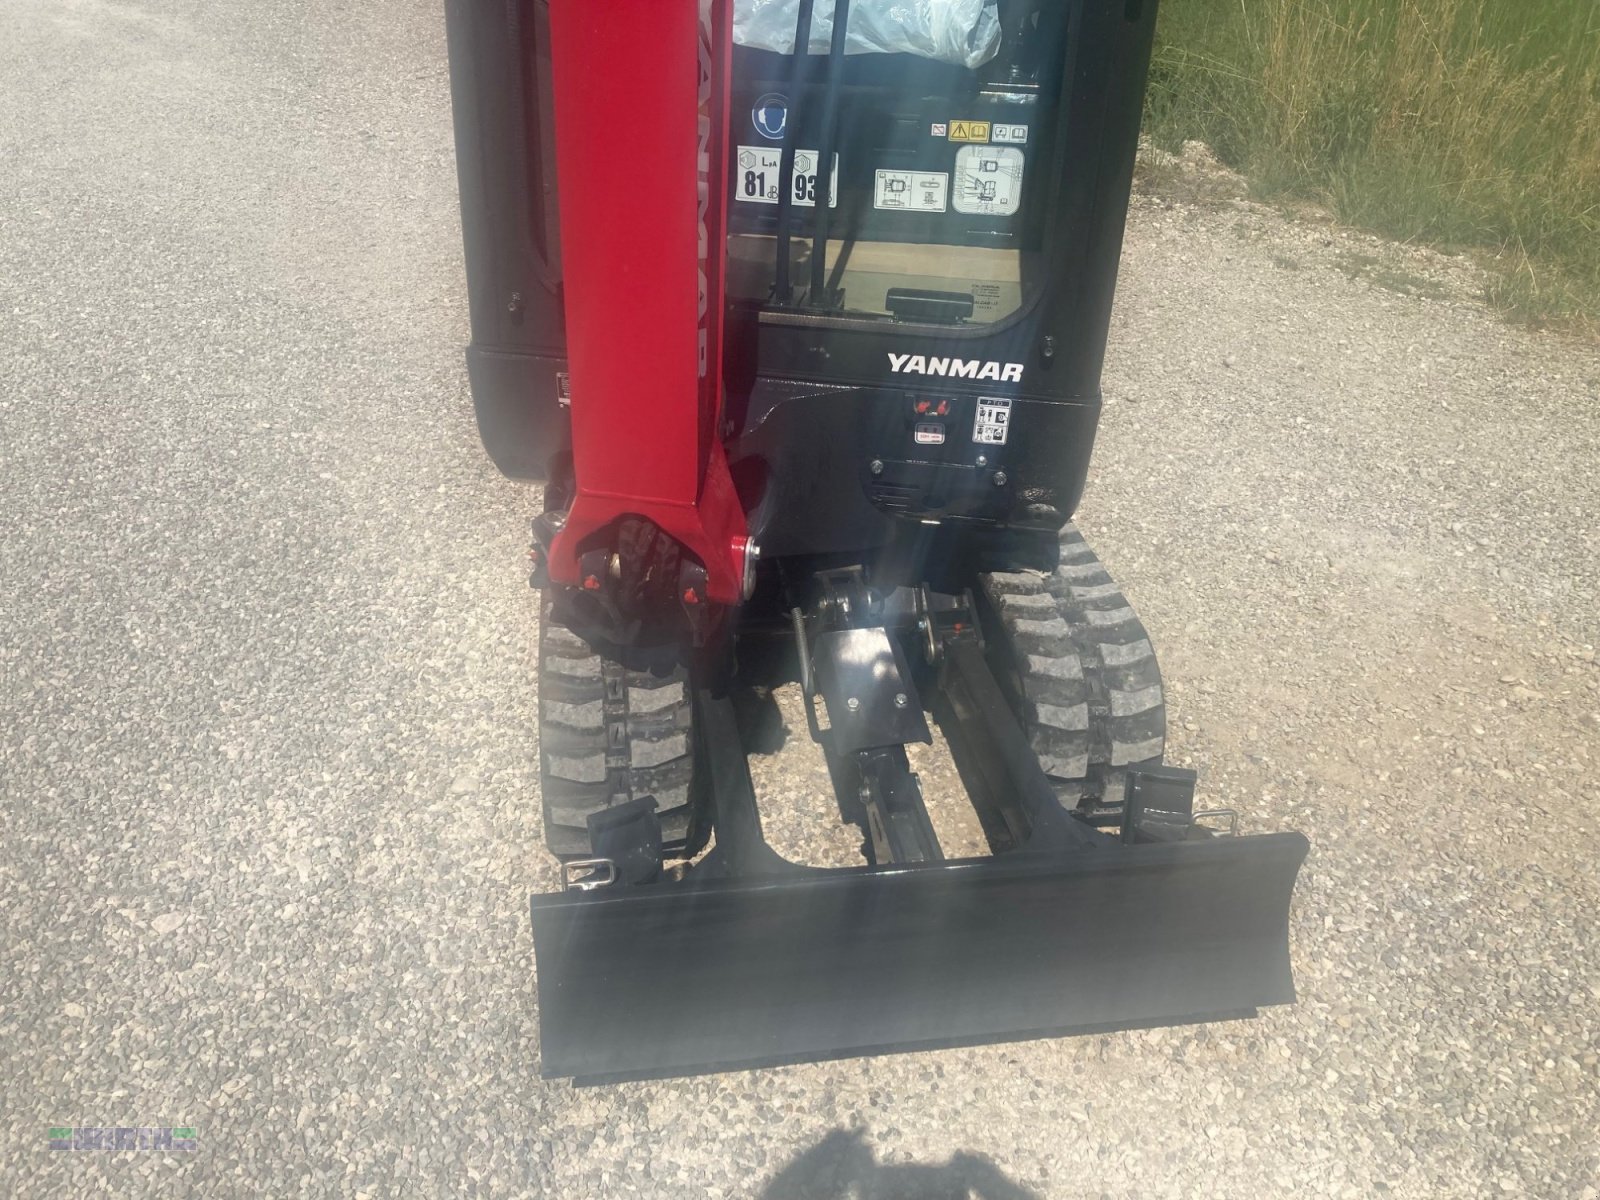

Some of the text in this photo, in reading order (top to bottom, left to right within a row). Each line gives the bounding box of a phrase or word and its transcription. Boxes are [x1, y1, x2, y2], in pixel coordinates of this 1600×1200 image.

[744, 170, 765, 197] 81
[795, 174, 816, 202] 93
[887, 352, 1025, 383] YANMAR
